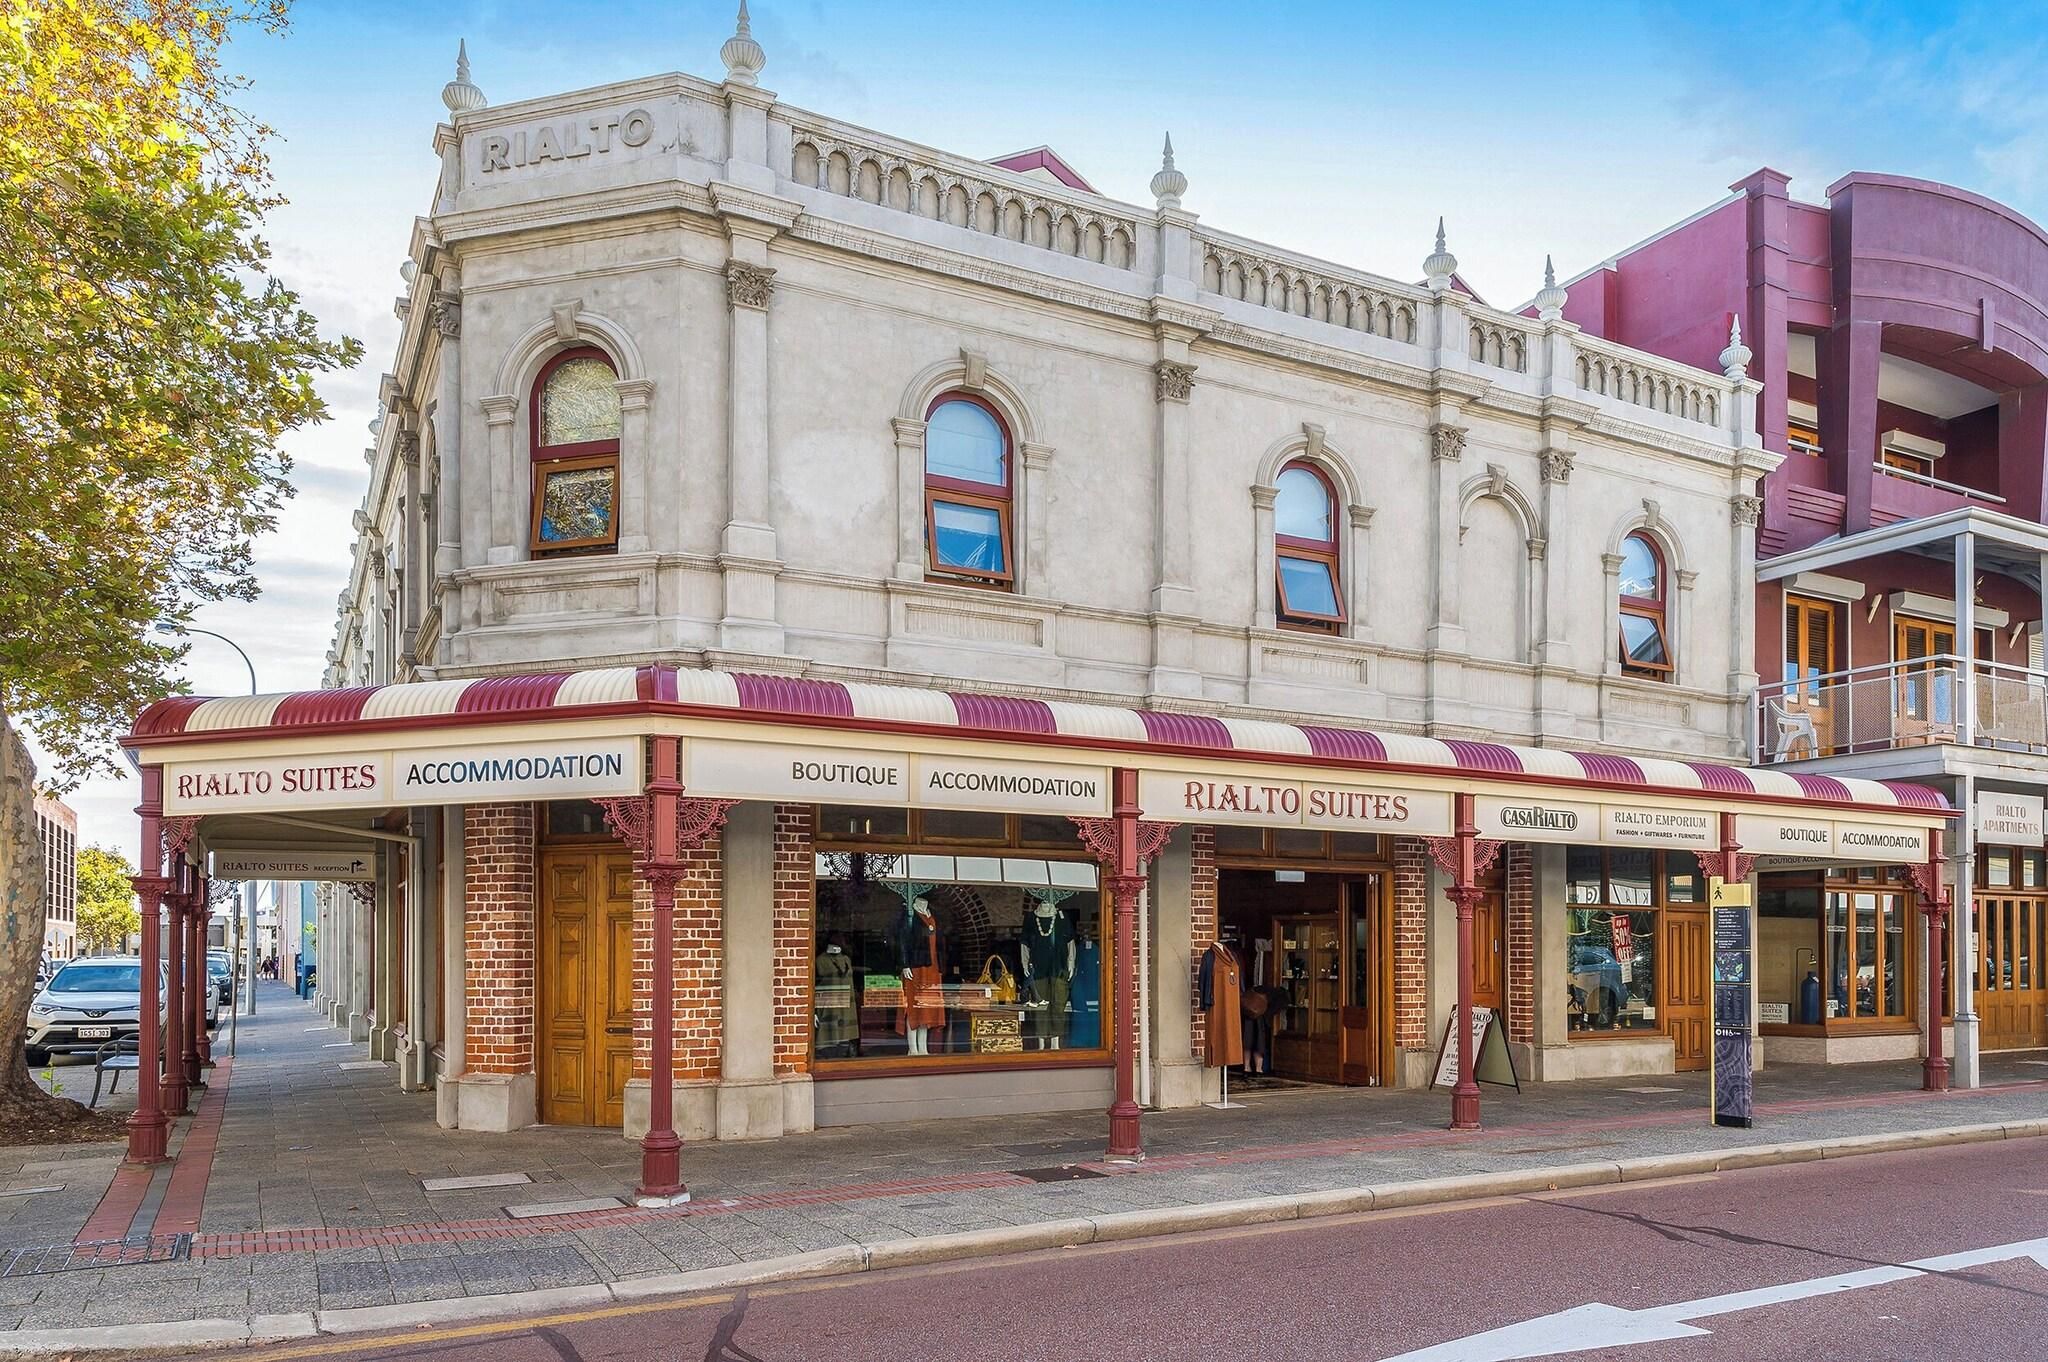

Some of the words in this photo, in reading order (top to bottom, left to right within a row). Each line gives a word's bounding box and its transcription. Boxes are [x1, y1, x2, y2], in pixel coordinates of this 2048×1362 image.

[481, 109, 655, 173] RIALTO
[406, 753, 622, 786] ACCOMMODATION
[792, 761, 898, 787] BOUTIQUE
[178, 771, 272, 800] RIALTO
[281, 764, 377, 793] SUITES
[929, 770, 1097, 799] ACCOMMODATION
[1184, 781, 1300, 816] RIALTO
[1309, 789, 1409, 823] SUITES
[1614, 811, 1653, 826] RIALTO
[1655, 814, 1707, 828] EMPORIUM
[1995, 804, 2027, 819] RIALTO
[1616, 828, 1639, 836] FASHION
[1678, 833, 1706, 841] FURNITURE
[1780, 827, 1828, 843] BOUTIQUE
[1983, 819, 2040, 836] APARTMENTS
[1842, 832, 1920, 849] ACCOMMODATION
[222, 862, 266, 872] RIALTO
[268, 863, 309, 873] SUITES
[1768, 857, 1801, 865] BOUTIQUE
[1615, 927, 1631, 946] 50%
